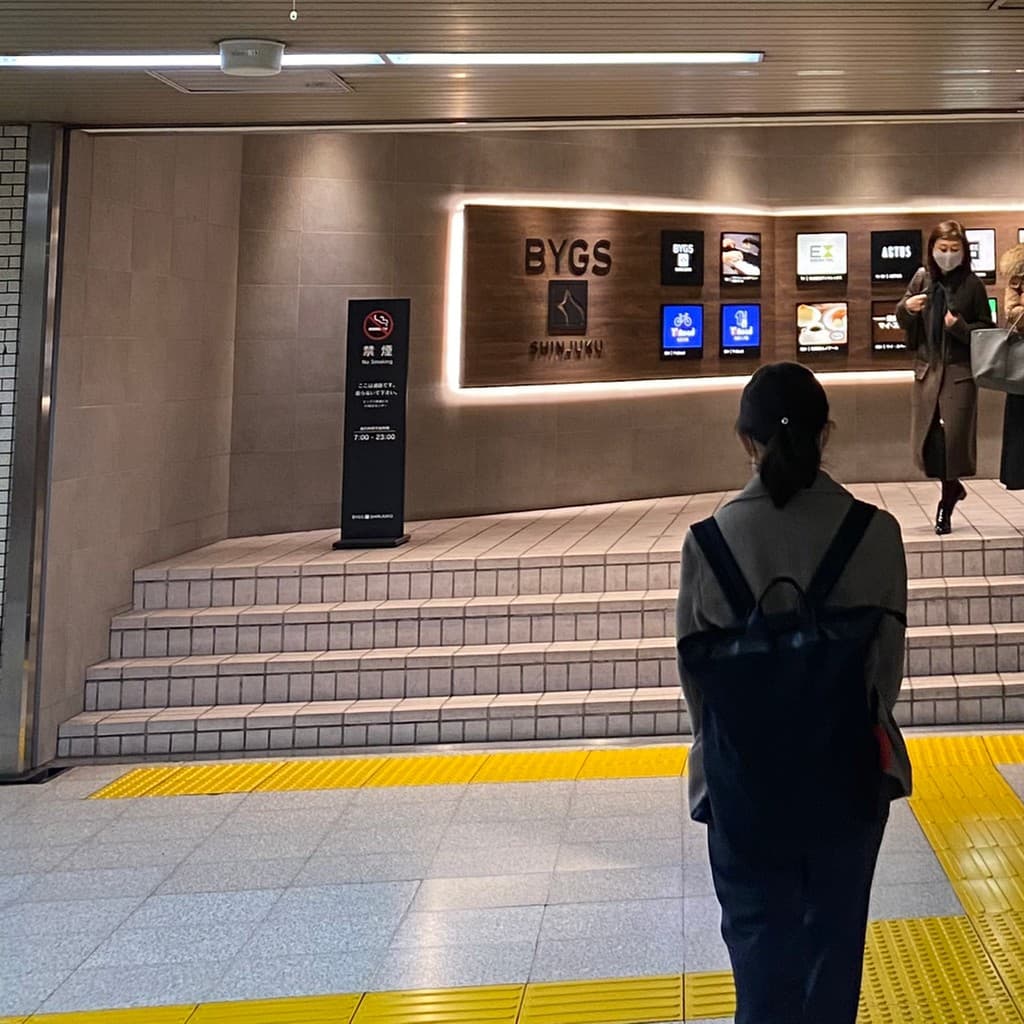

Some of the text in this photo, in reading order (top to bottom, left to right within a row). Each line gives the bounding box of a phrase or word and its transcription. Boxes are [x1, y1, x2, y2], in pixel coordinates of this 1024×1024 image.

[524, 238, 612, 276] BYGS
[672, 243, 694, 254] BYGS
[529, 340, 604, 359] SHINJUKU
